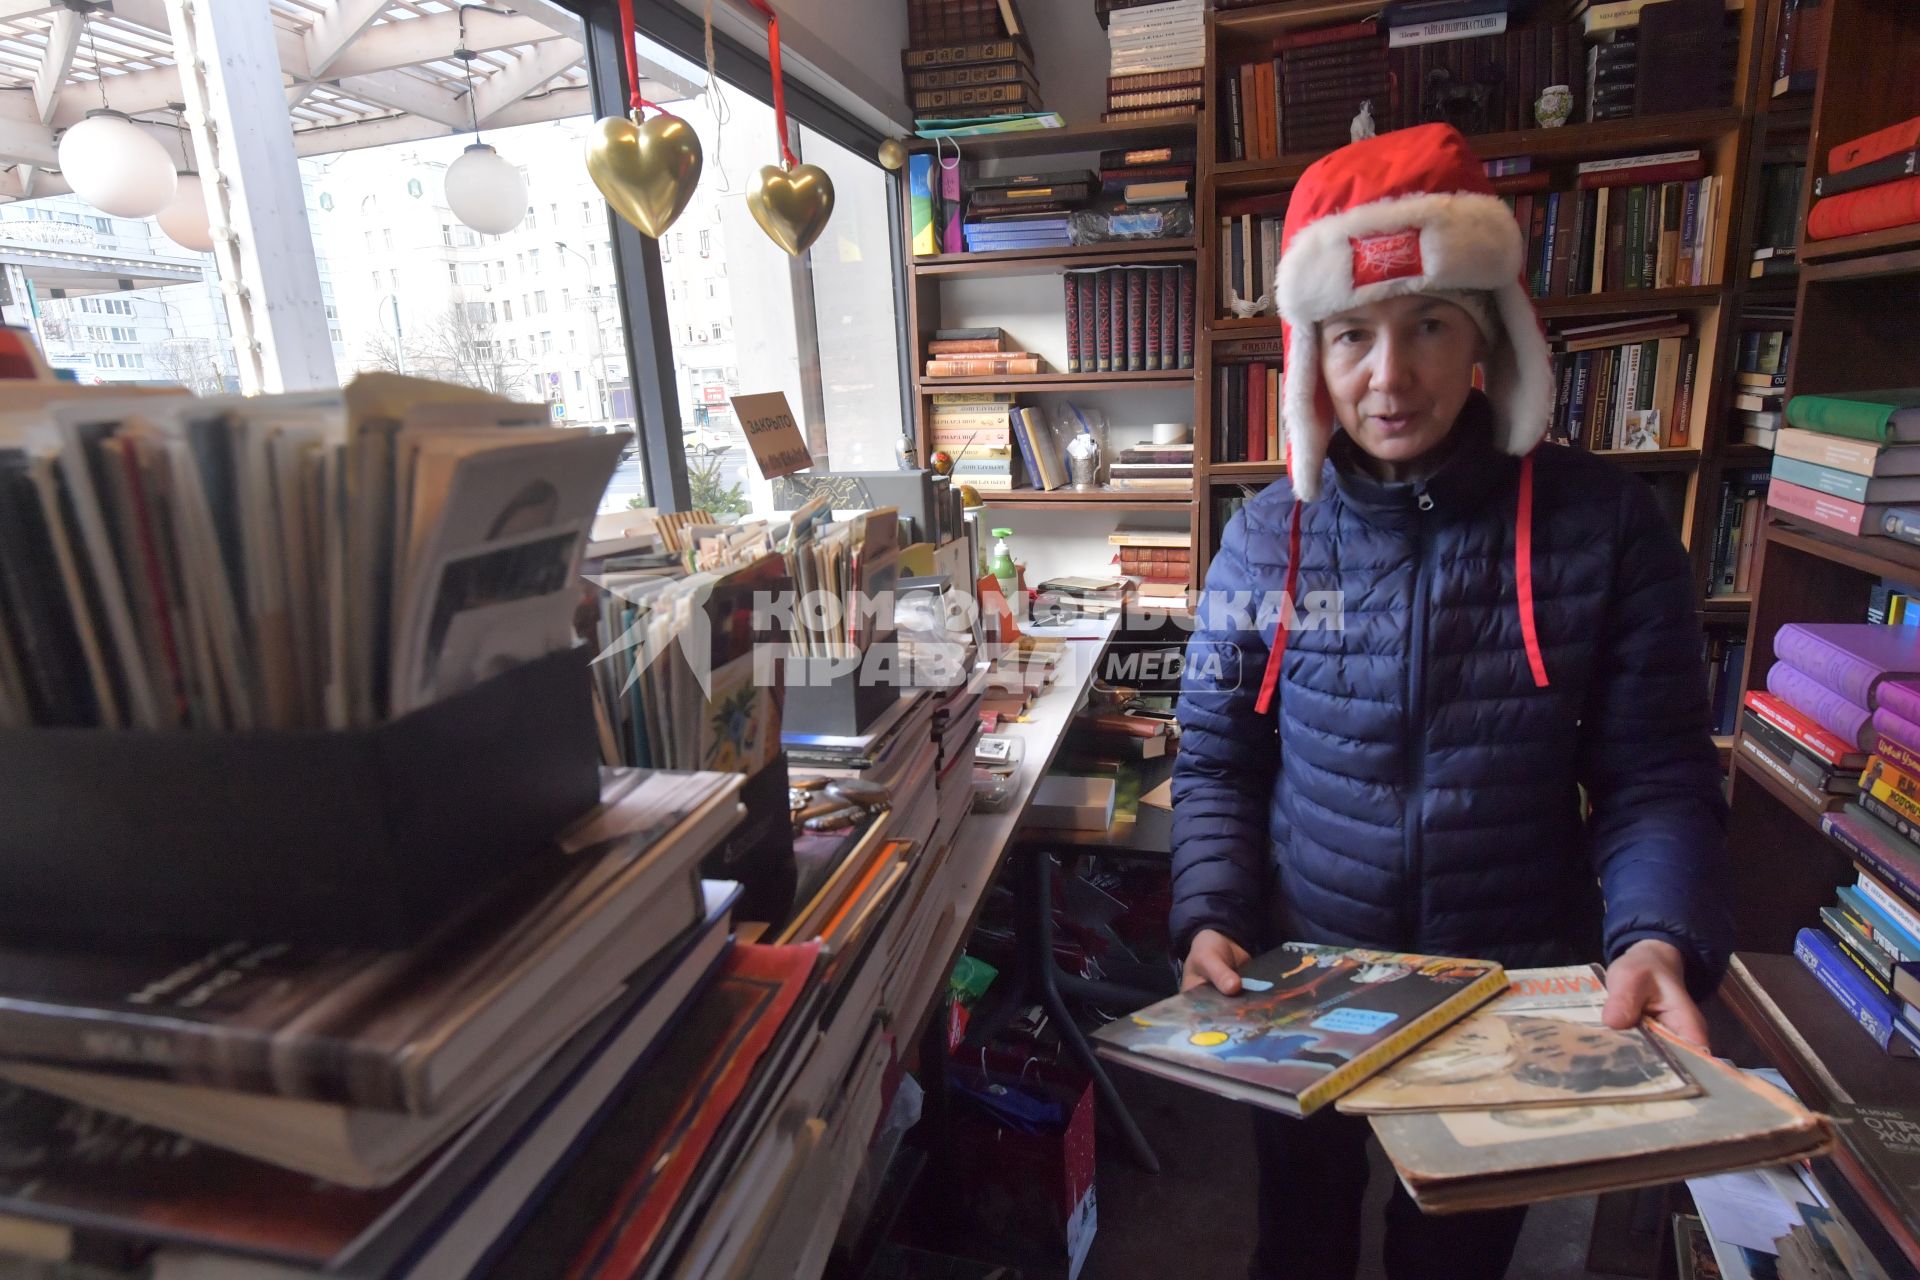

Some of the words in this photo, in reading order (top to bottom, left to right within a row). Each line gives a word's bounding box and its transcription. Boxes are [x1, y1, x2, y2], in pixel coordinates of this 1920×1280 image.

[1067, 280, 1078, 355] ШЕКСПИР
[1131, 275, 1142, 353] ШЕКСПИР
[1148, 277, 1159, 352] ШЕКСПИР
[746, 414, 792, 435] ЗАКРЫТО
